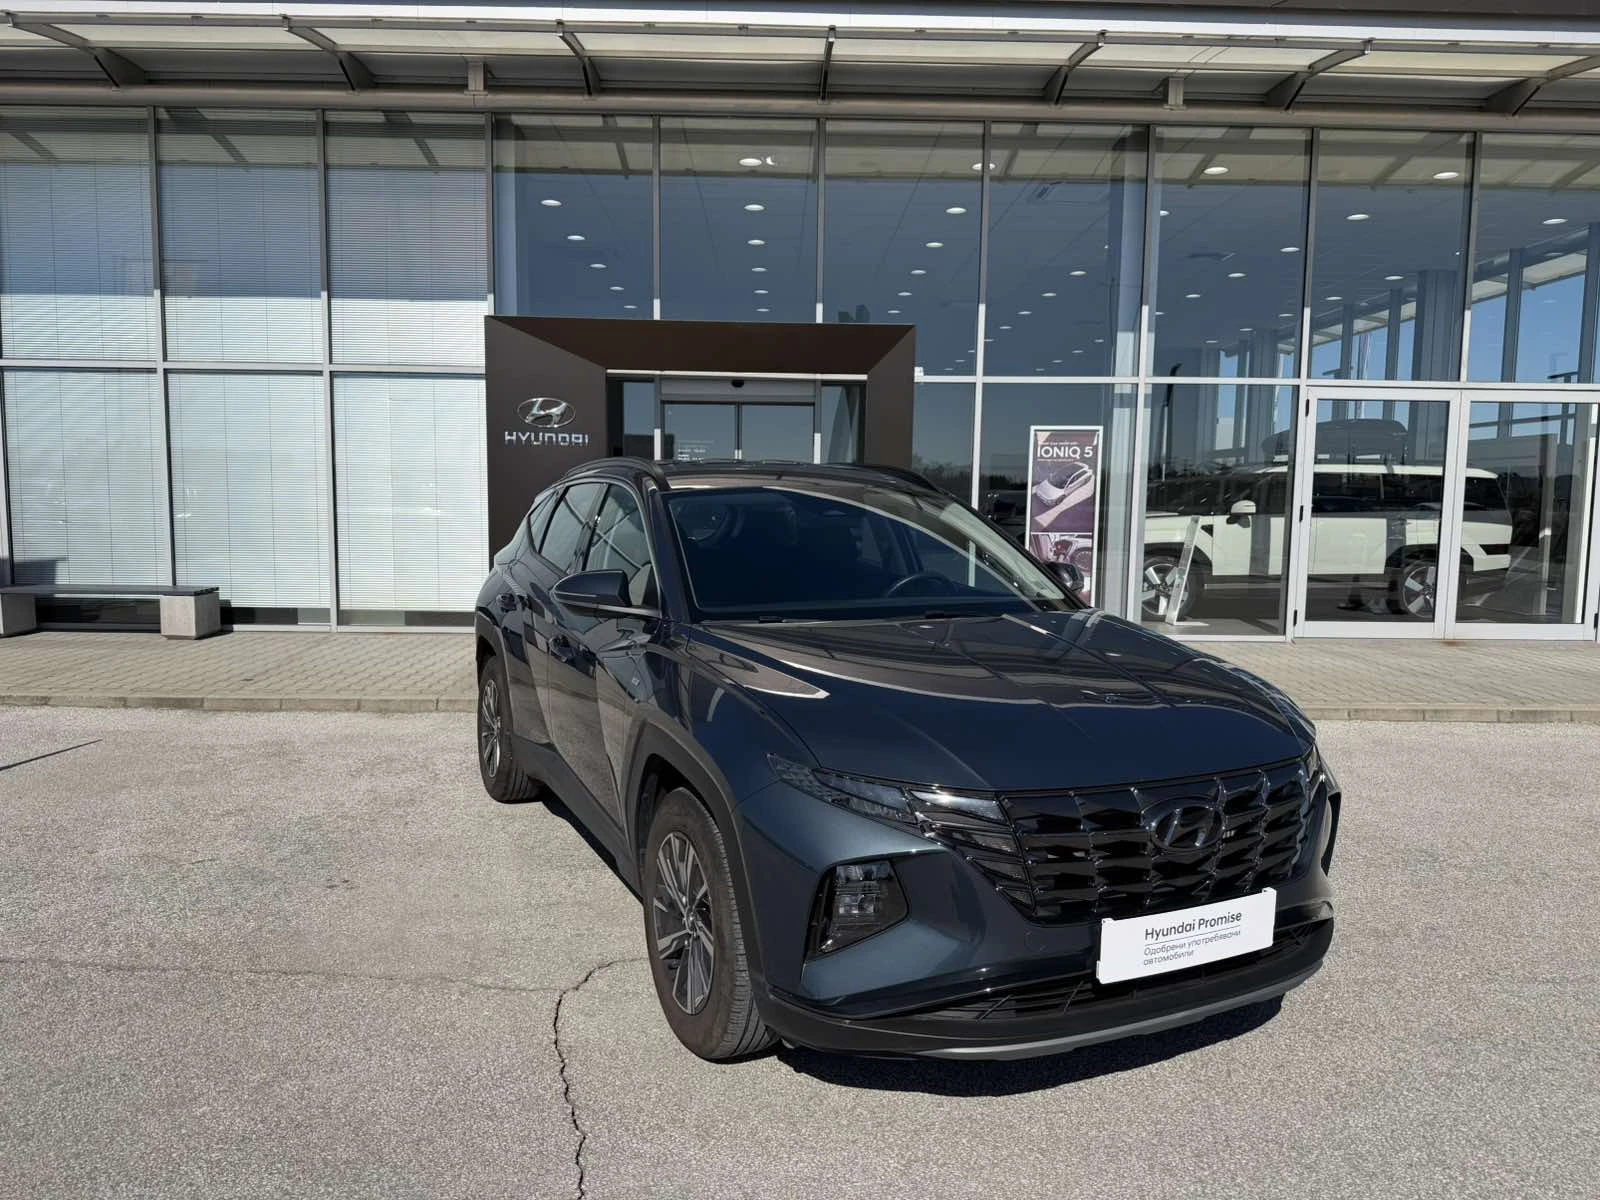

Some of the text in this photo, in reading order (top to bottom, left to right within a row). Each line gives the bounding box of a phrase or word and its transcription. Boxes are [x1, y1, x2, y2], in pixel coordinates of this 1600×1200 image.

[504, 431, 590, 446] HYUNDAI
[1037, 446, 1094, 460] IONIQ 5
[1144, 911, 1242, 941] Hyundai Promise
[1143, 942, 1187, 956] Одобрени
[1143, 949, 1194, 966] автомобили
